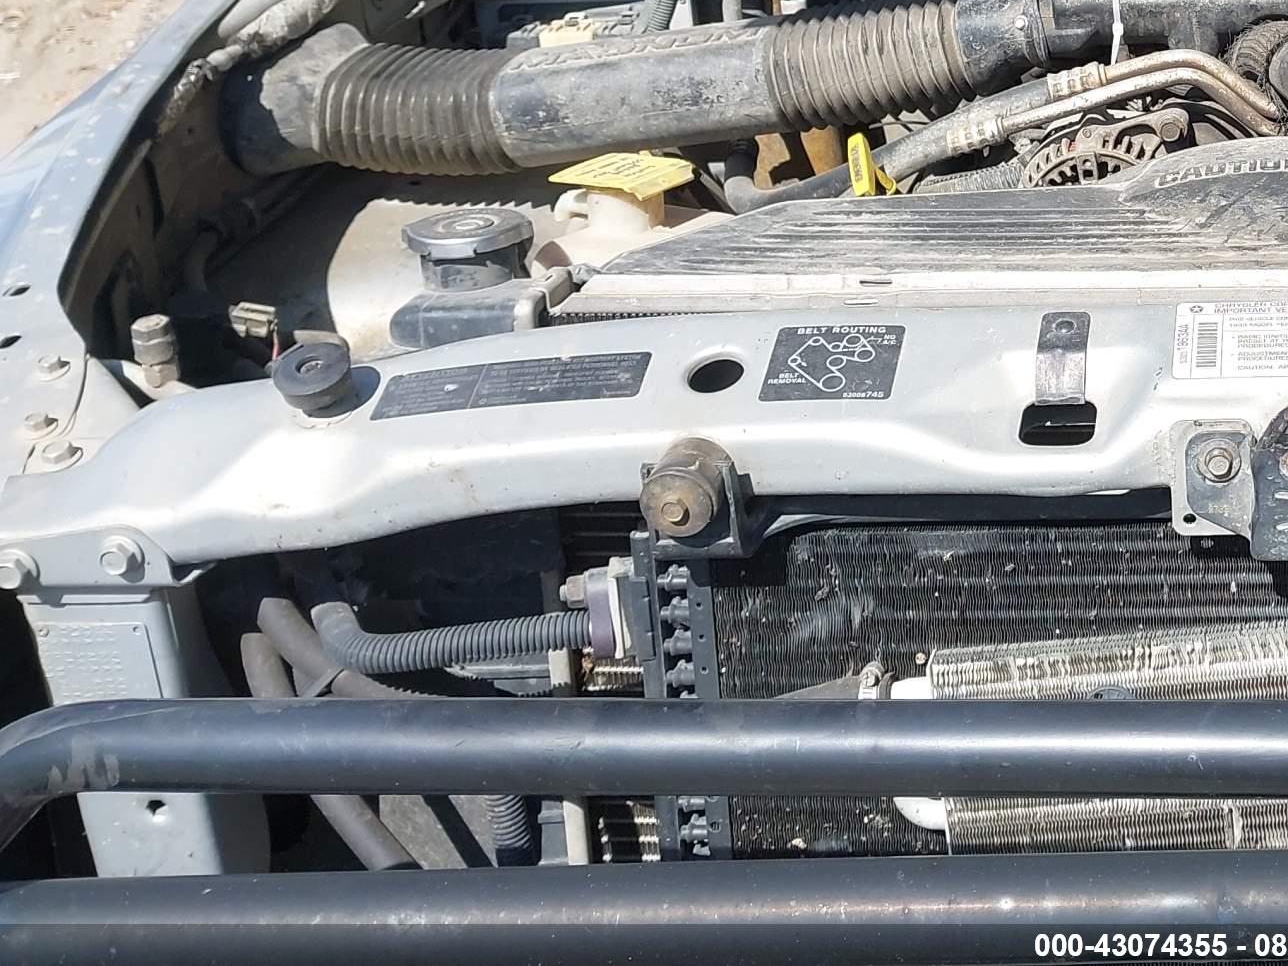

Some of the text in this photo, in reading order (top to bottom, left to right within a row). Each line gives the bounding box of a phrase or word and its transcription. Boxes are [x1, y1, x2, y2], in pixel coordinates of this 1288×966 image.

[797, 326, 887, 335] BELT ROUTING
[767, 377, 807, 385] REMOVAL
